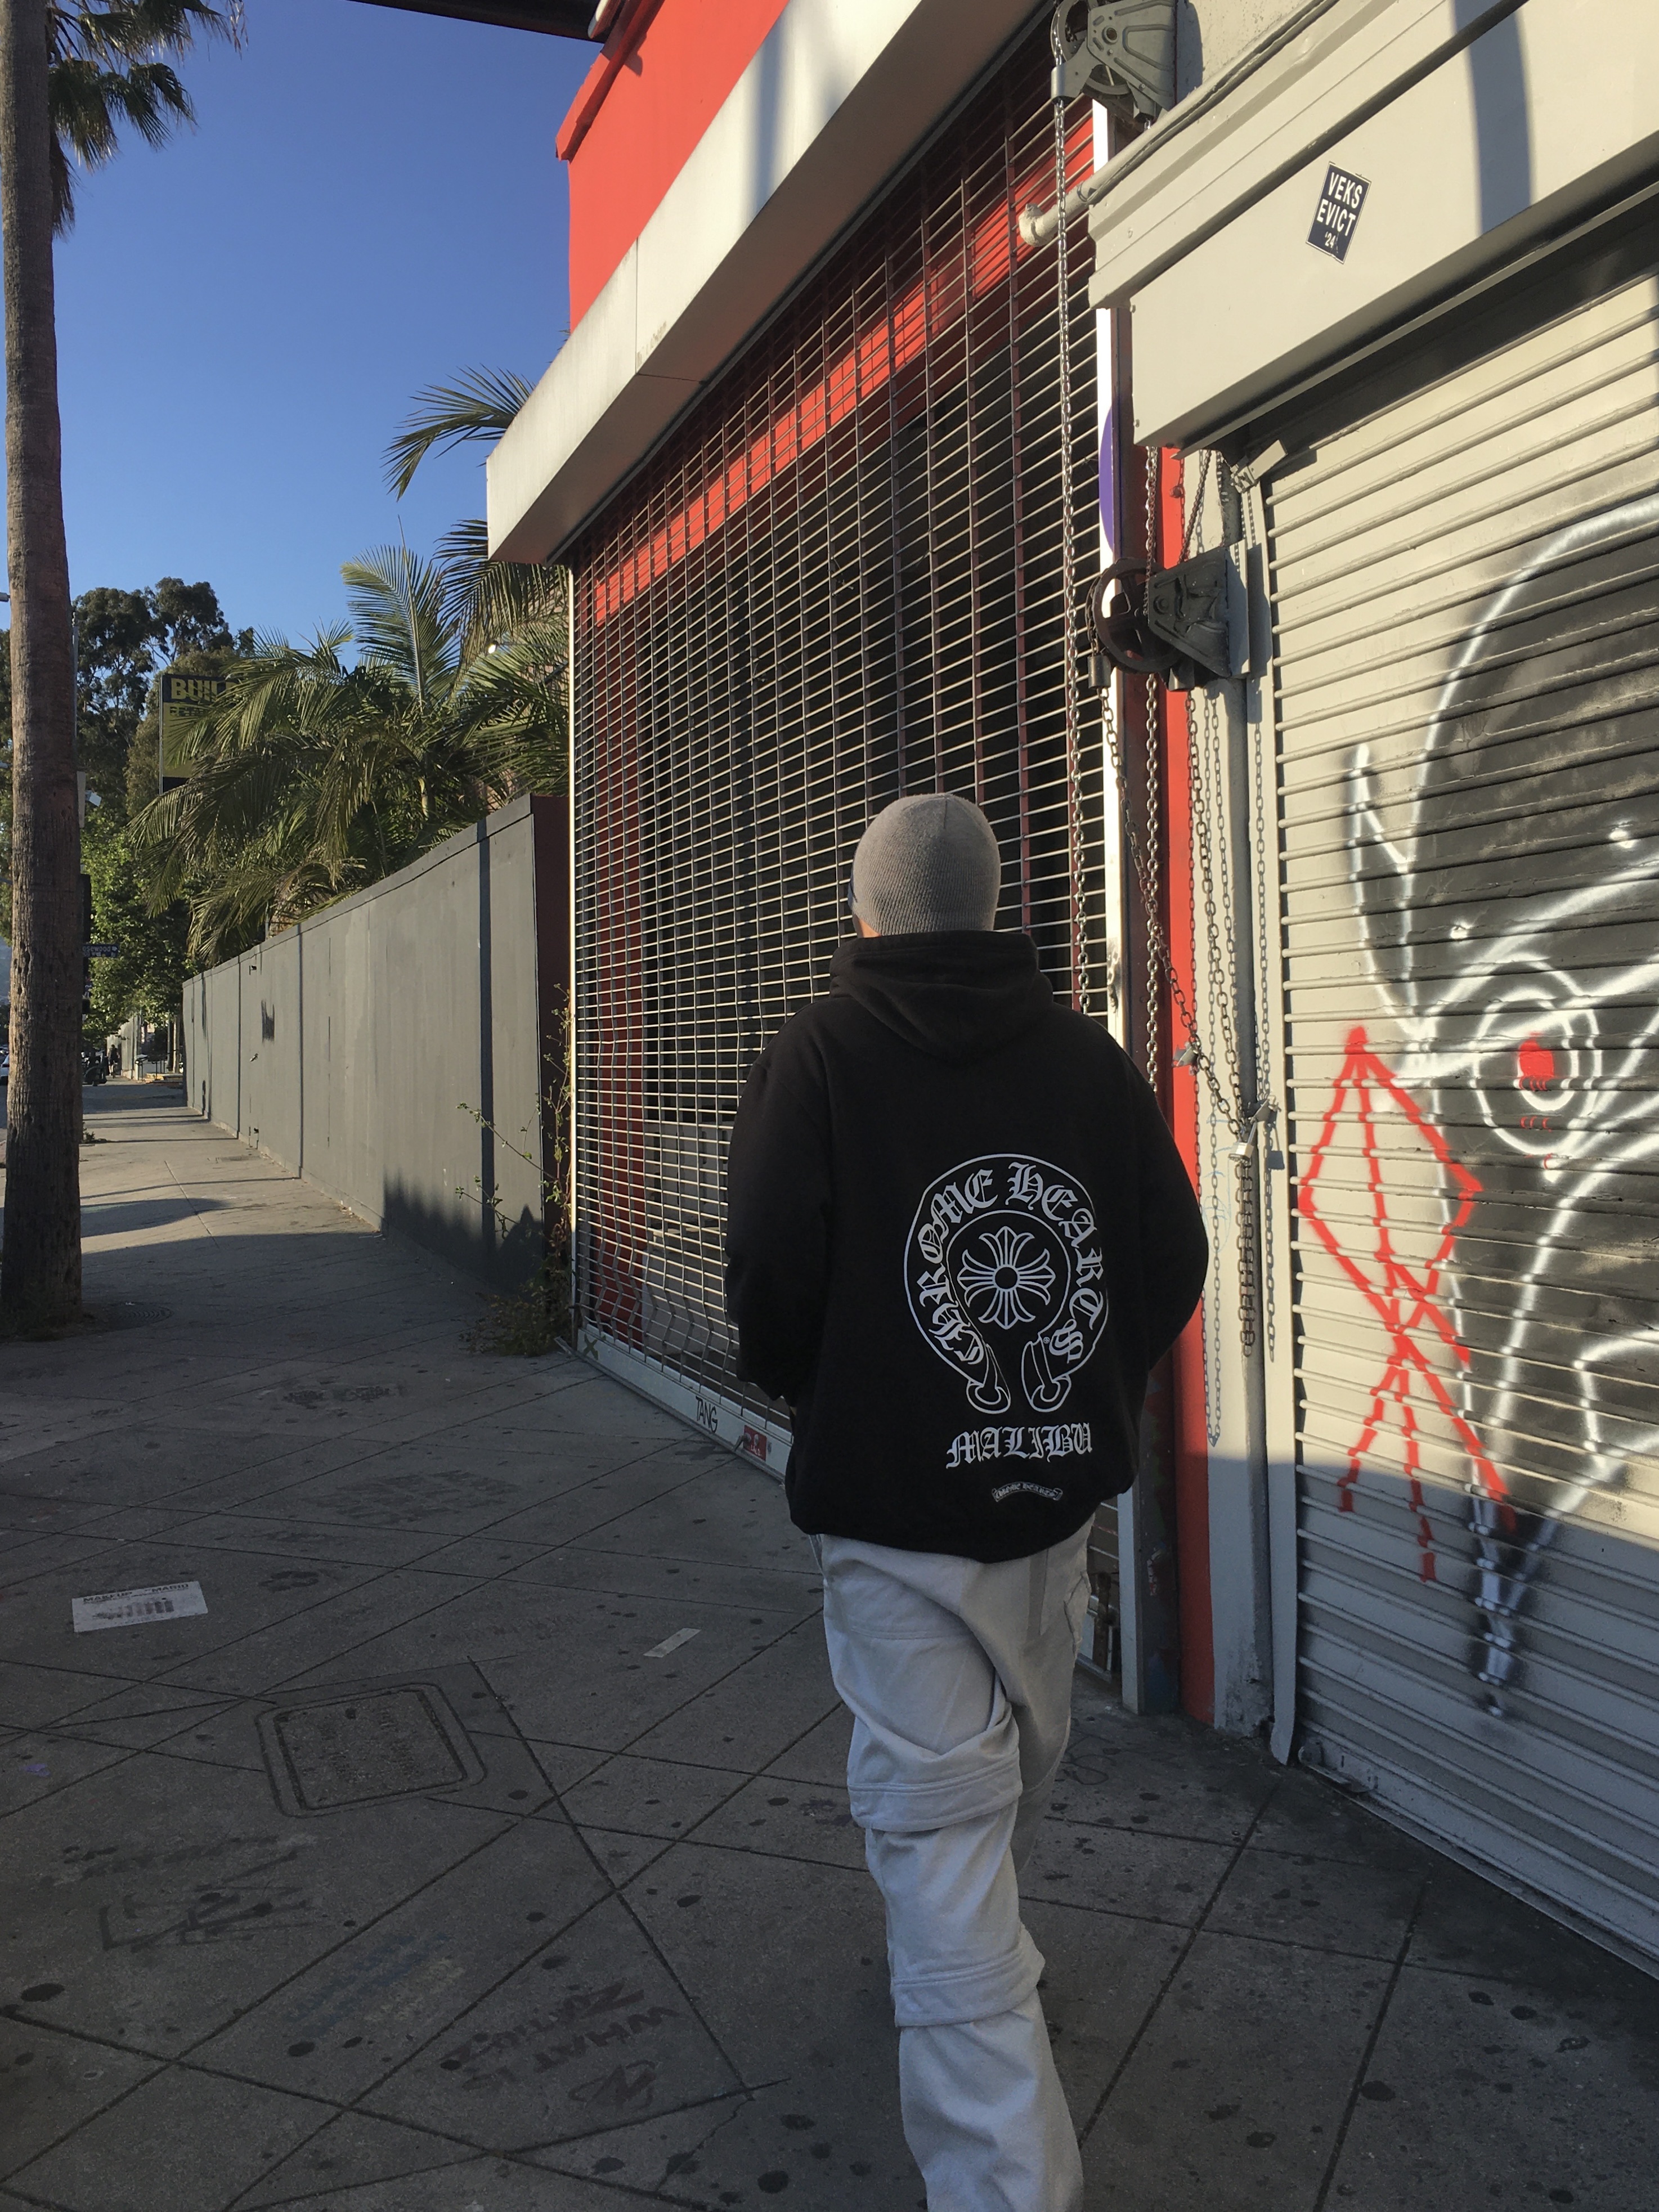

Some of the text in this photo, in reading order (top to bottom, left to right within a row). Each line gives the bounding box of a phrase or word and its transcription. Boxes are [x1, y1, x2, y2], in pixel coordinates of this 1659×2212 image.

[1328, 172, 1362, 209] VEKS
[1317, 199, 1356, 236] EVICT
[918, 1162, 1104, 1365] CHROME HEARTS
[696, 1396, 718, 1433] TANG
[946, 1423, 1092, 1469] MALIBU
